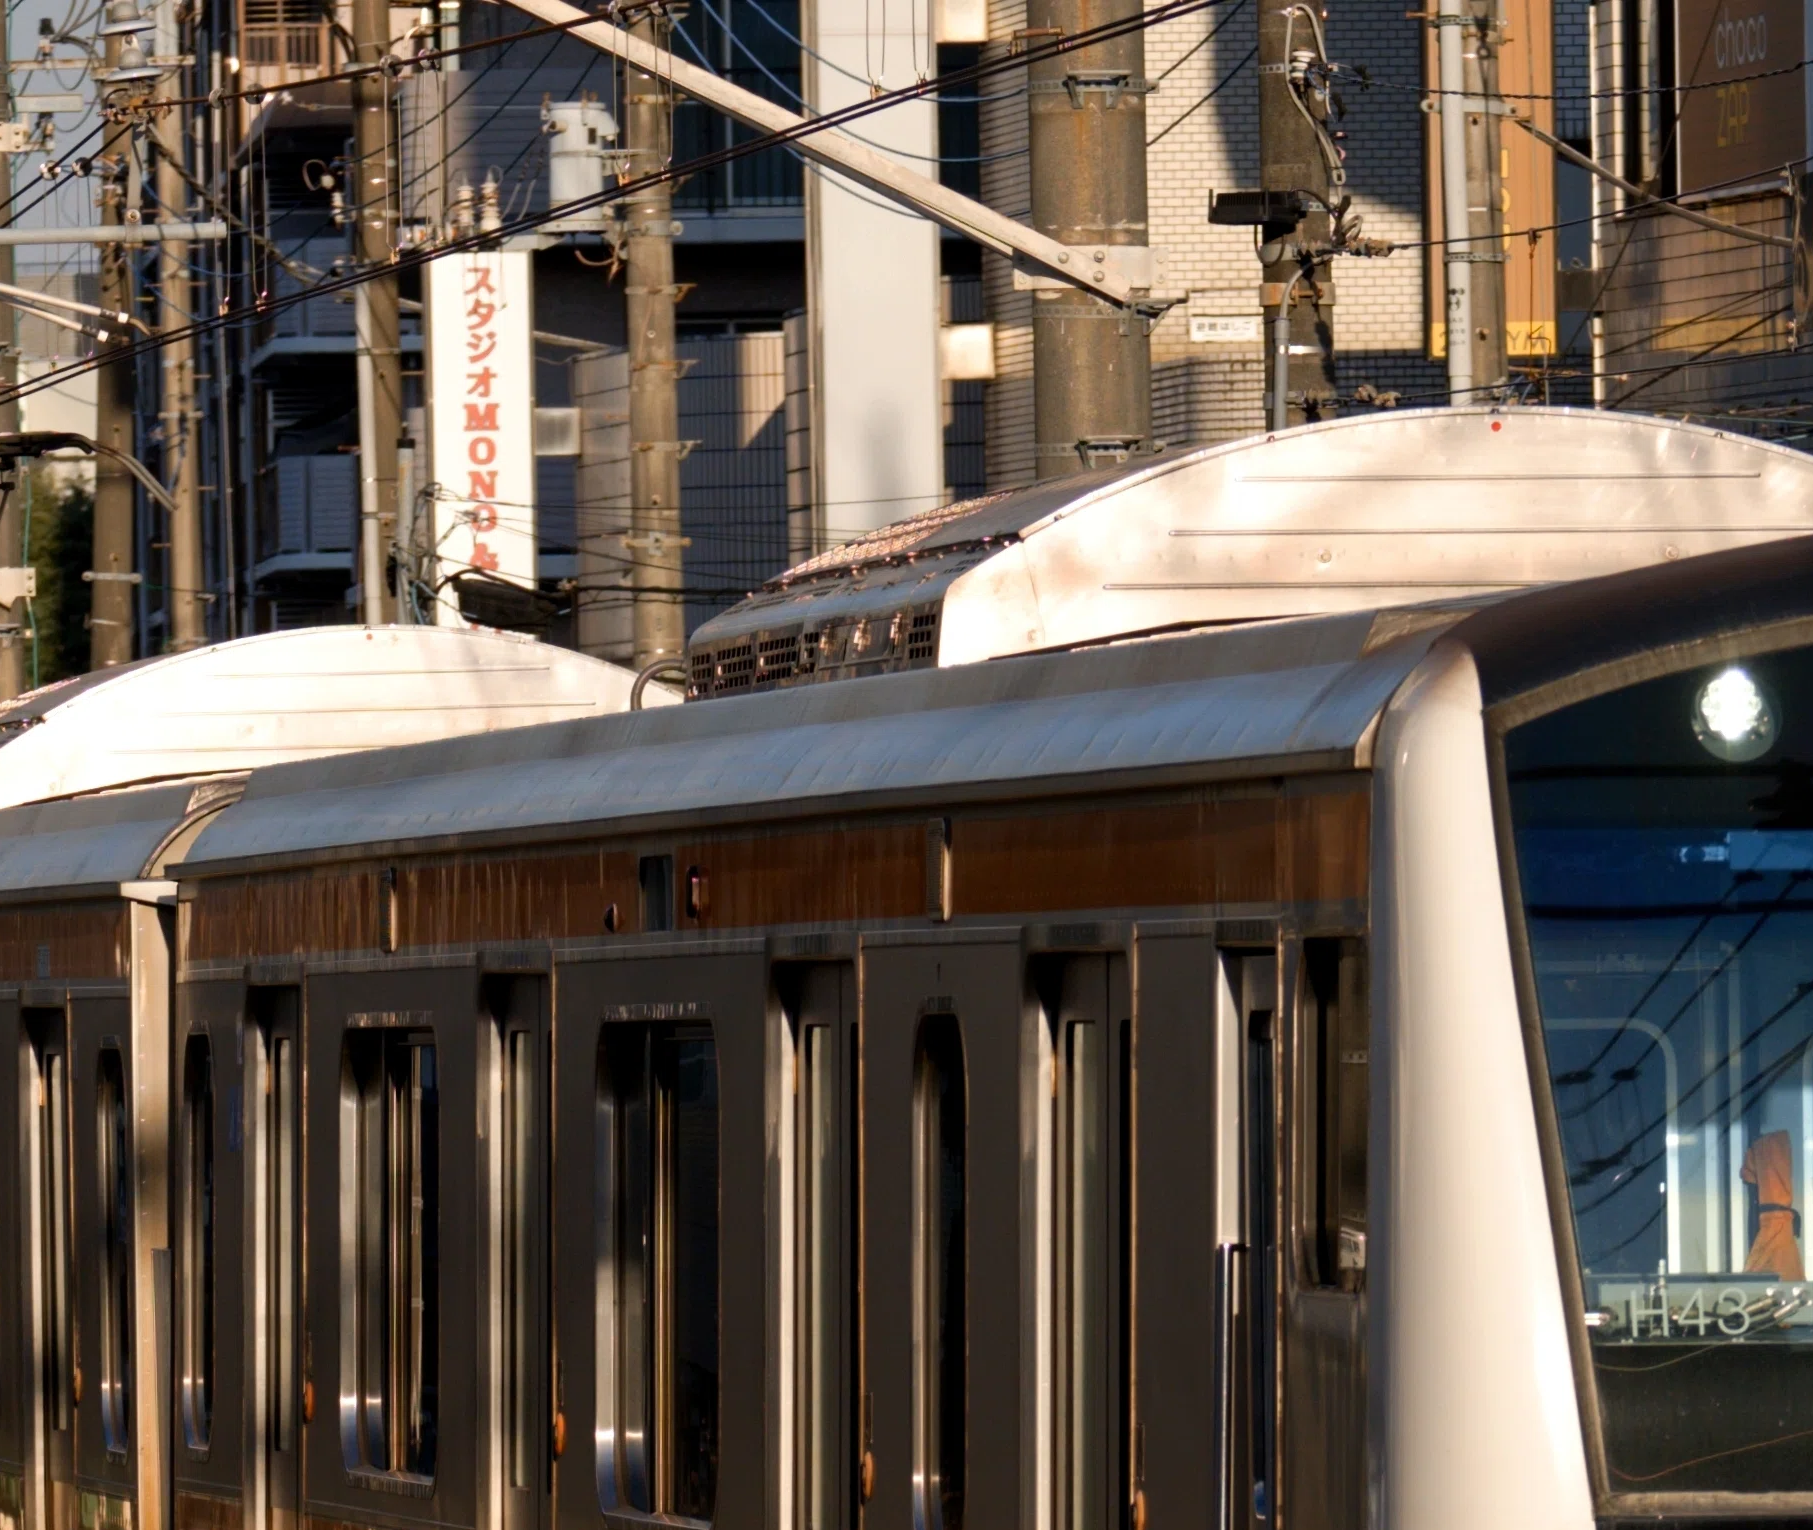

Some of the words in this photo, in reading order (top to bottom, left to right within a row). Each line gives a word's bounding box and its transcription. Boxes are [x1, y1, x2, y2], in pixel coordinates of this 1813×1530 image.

[1715, 8, 1767, 69] choco
[1716, 82, 1750, 148] ZAP
[1630, 1287, 1752, 1338] H43
